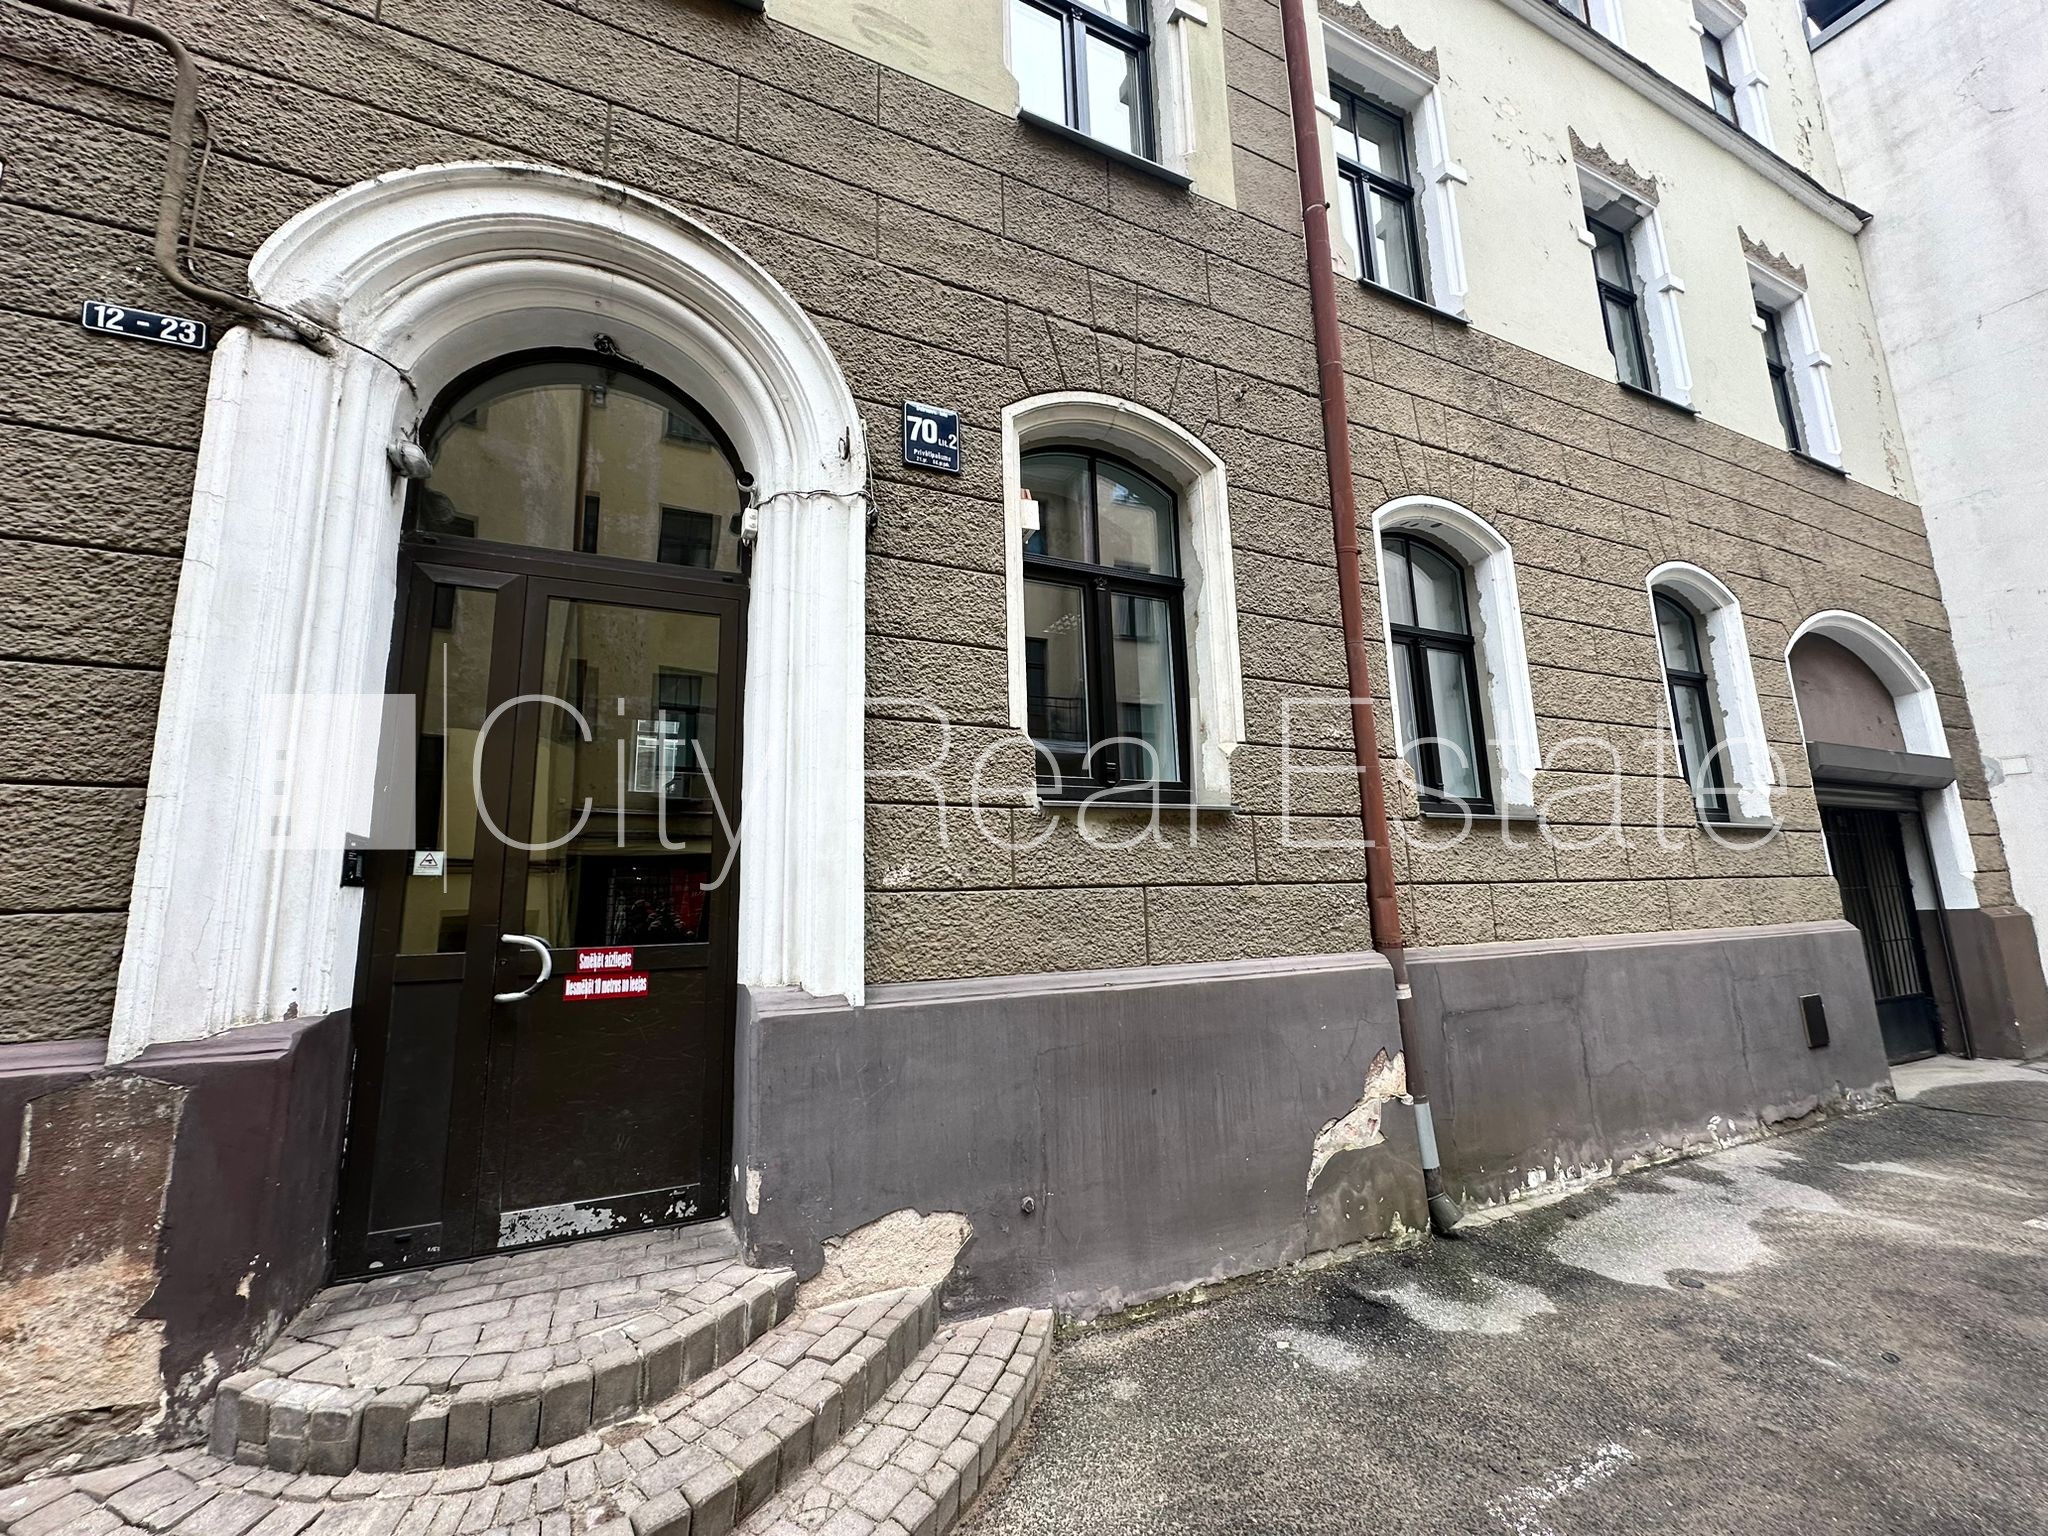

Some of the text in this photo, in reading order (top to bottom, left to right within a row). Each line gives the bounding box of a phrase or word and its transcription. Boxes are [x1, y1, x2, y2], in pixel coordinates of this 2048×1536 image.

[94, 305, 125, 331] 12
[160, 318, 196, 344] 23
[907, 415, 938, 444] 70
